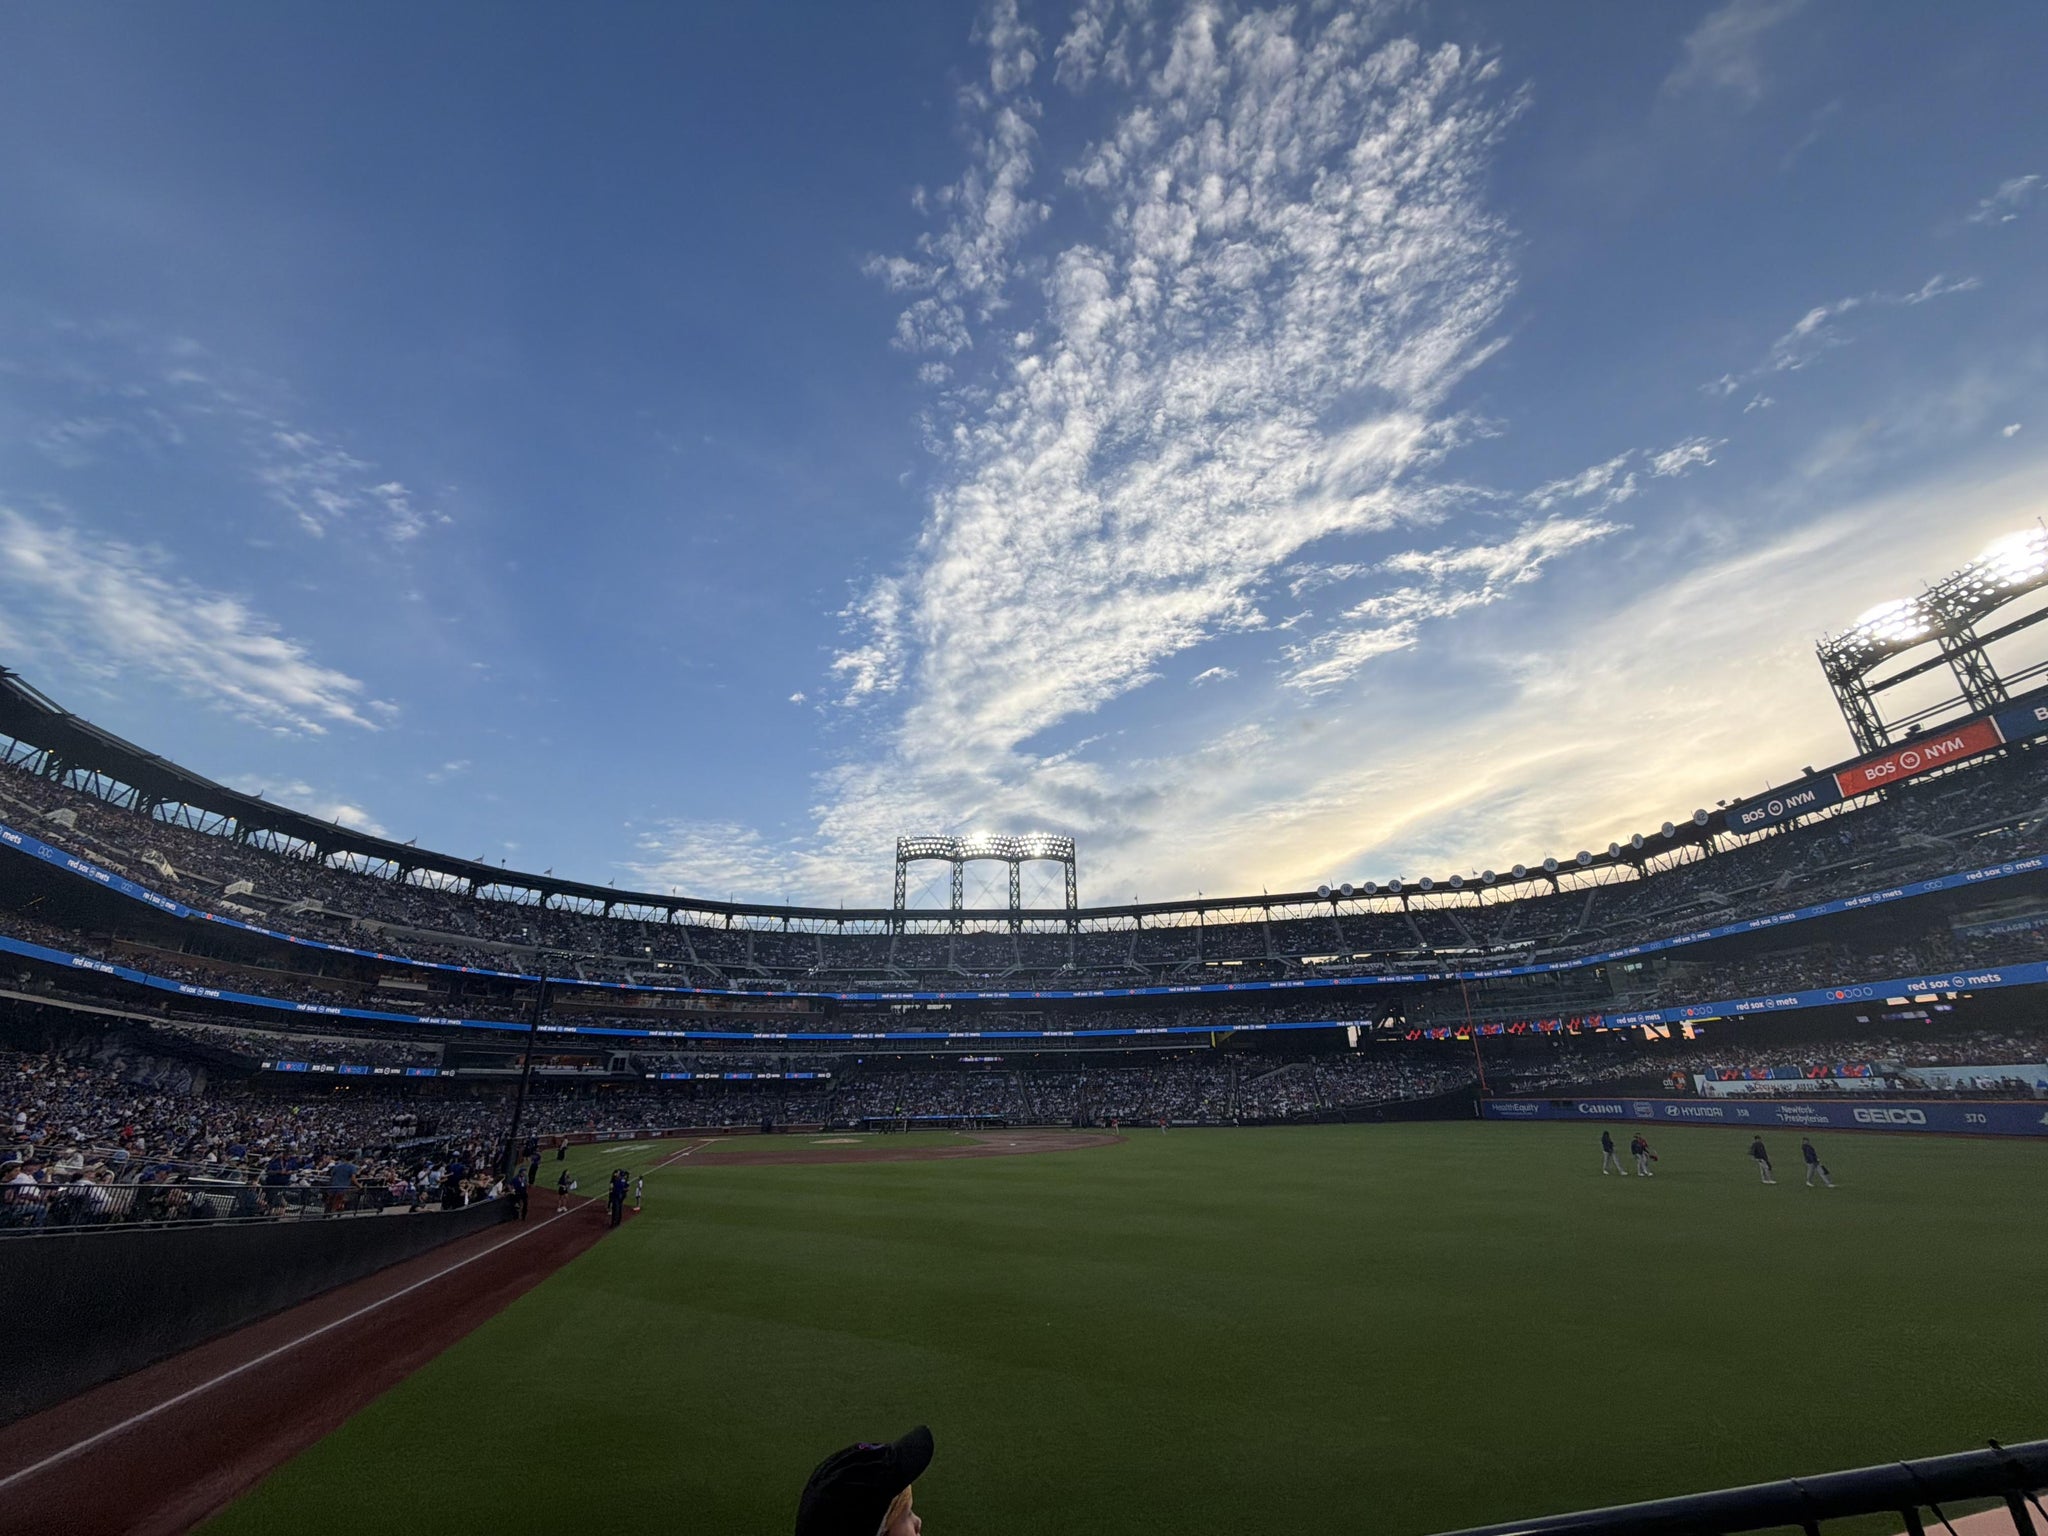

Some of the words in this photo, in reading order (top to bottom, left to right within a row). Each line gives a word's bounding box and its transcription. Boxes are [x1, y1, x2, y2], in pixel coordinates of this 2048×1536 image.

[1864, 762, 1896, 782] BOS
[1924, 737, 1964, 760] NYM
[1741, 808, 1765, 824] BOS
[1786, 790, 1816, 809] NYM
[2, 830, 22, 845] mets
[66, 859, 80, 869] red
[78, 864, 90, 873] sox
[94, 871, 110, 882] mets
[1966, 872, 1982, 881] red
[1984, 868, 2001, 877] sox
[2016, 858, 2042, 870] mets
[1882, 889, 1903, 898] mets
[1779, 913, 1796, 921] mets
[72, 957, 83, 966] red
[83, 959, 93, 969] sox
[100, 964, 114, 974] mets
[1908, 980, 1927, 992] red
[1929, 979, 1950, 990] sox
[1968, 972, 2002, 985] mets
[1750, 1001, 1764, 1009] sox
[1776, 998, 1798, 1006] mets
[1492, 1103, 1539, 1112] HealthEquity
[1578, 1103, 1623, 1114] Canon
[1681, 1106, 1723, 1117] HYUNDAI
[1737, 1108, 1750, 1117] 358
[1784, 1114, 1829, 1124] Presbyterian
[1853, 1108, 1926, 1124] GEICO
[1964, 1113, 1986, 1123] 370
